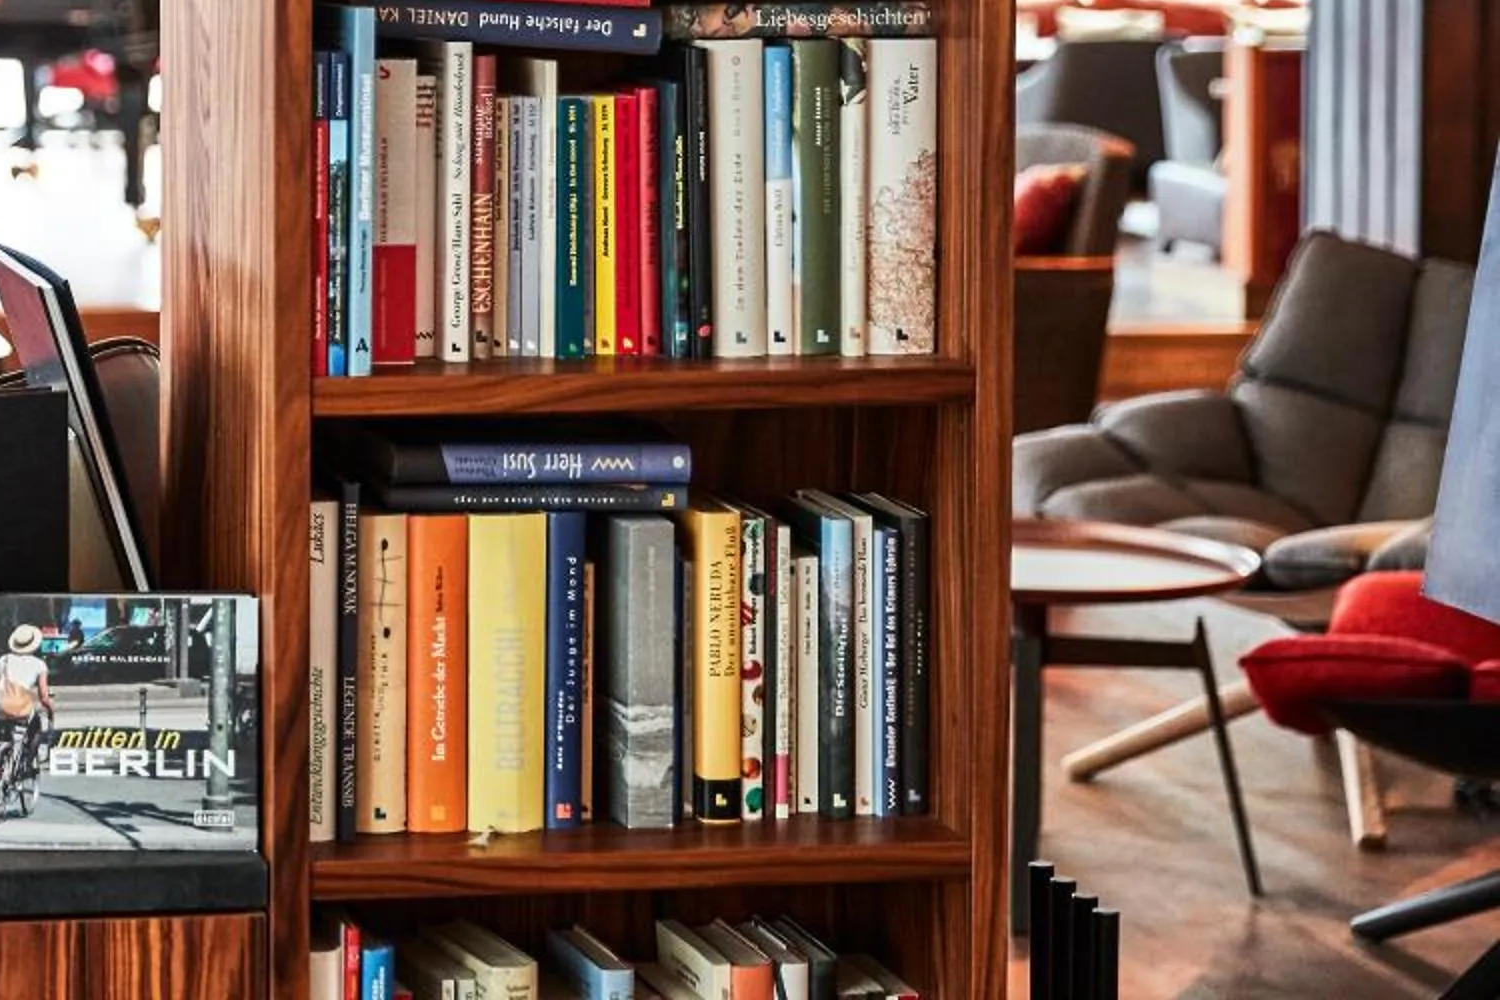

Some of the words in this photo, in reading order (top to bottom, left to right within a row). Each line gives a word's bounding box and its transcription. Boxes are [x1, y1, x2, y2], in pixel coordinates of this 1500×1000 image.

[407, 8, 469, 26] DANIEL
[479, 12, 520, 33] Hund
[525, 15, 579, 36] falsche
[585, 19, 612, 36] Der
[756, 8, 924, 30] Liebesgeschichten
[904, 64, 920, 103] Vater
[472, 193, 493, 313] ESCHENHAIN
[451, 290, 463, 328] George
[503, 453, 537, 476] Susi
[545, 452, 582, 477] Herr
[567, 556, 577, 600] Mond
[709, 561, 722, 623] NERUDA
[432, 616, 446, 657] Macht
[432, 661, 446, 681] der
[343, 676, 355, 739] LEGENDE
[432, 683, 446, 740] Getriebe
[57, 726, 146, 749] mitten
[154, 728, 181, 749] in
[50, 749, 235, 777] BERLIN
[432, 743, 446, 761] Im
